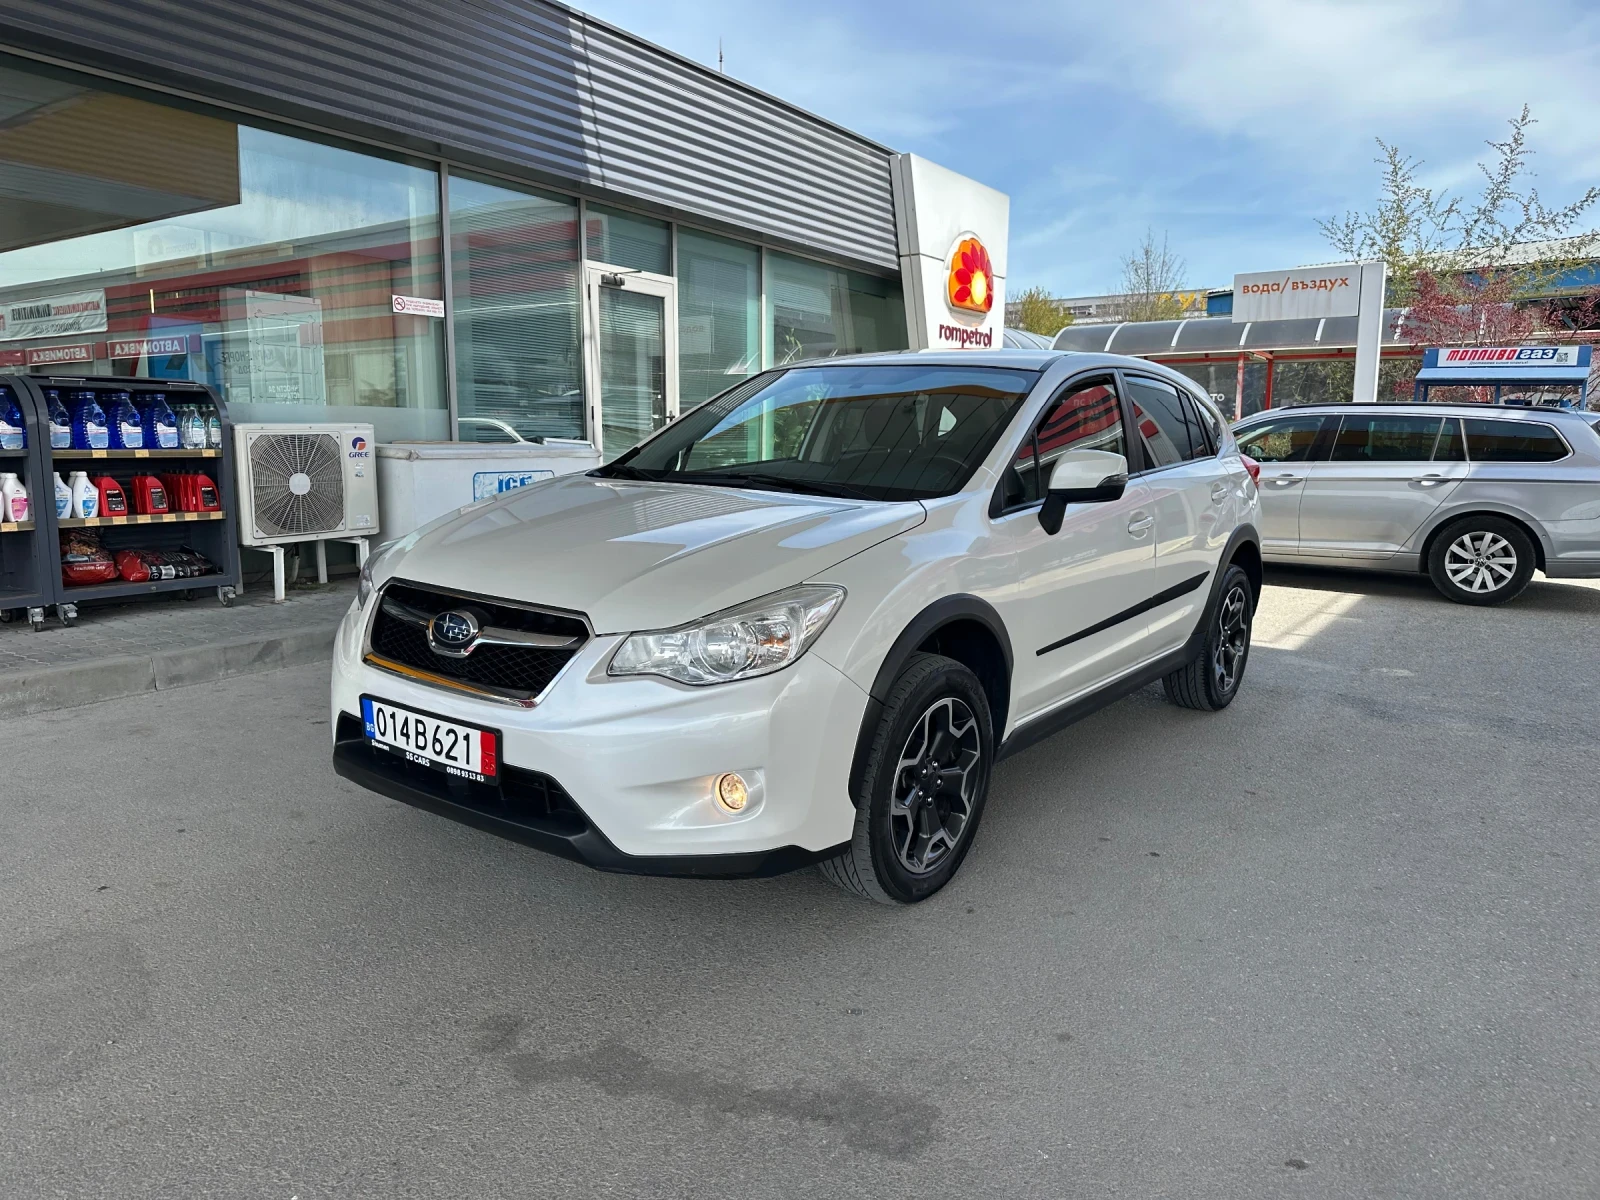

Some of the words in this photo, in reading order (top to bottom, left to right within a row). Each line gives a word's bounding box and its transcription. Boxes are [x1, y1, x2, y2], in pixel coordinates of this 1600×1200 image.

[1242, 277, 1349, 294] вода/въздух
[939, 324, 993, 348] rompetrol
[366, 722, 375, 733] BG
[376, 707, 470, 765] 014B621
[405, 751, 414, 761] SS
[413, 755, 430, 767] CARS
